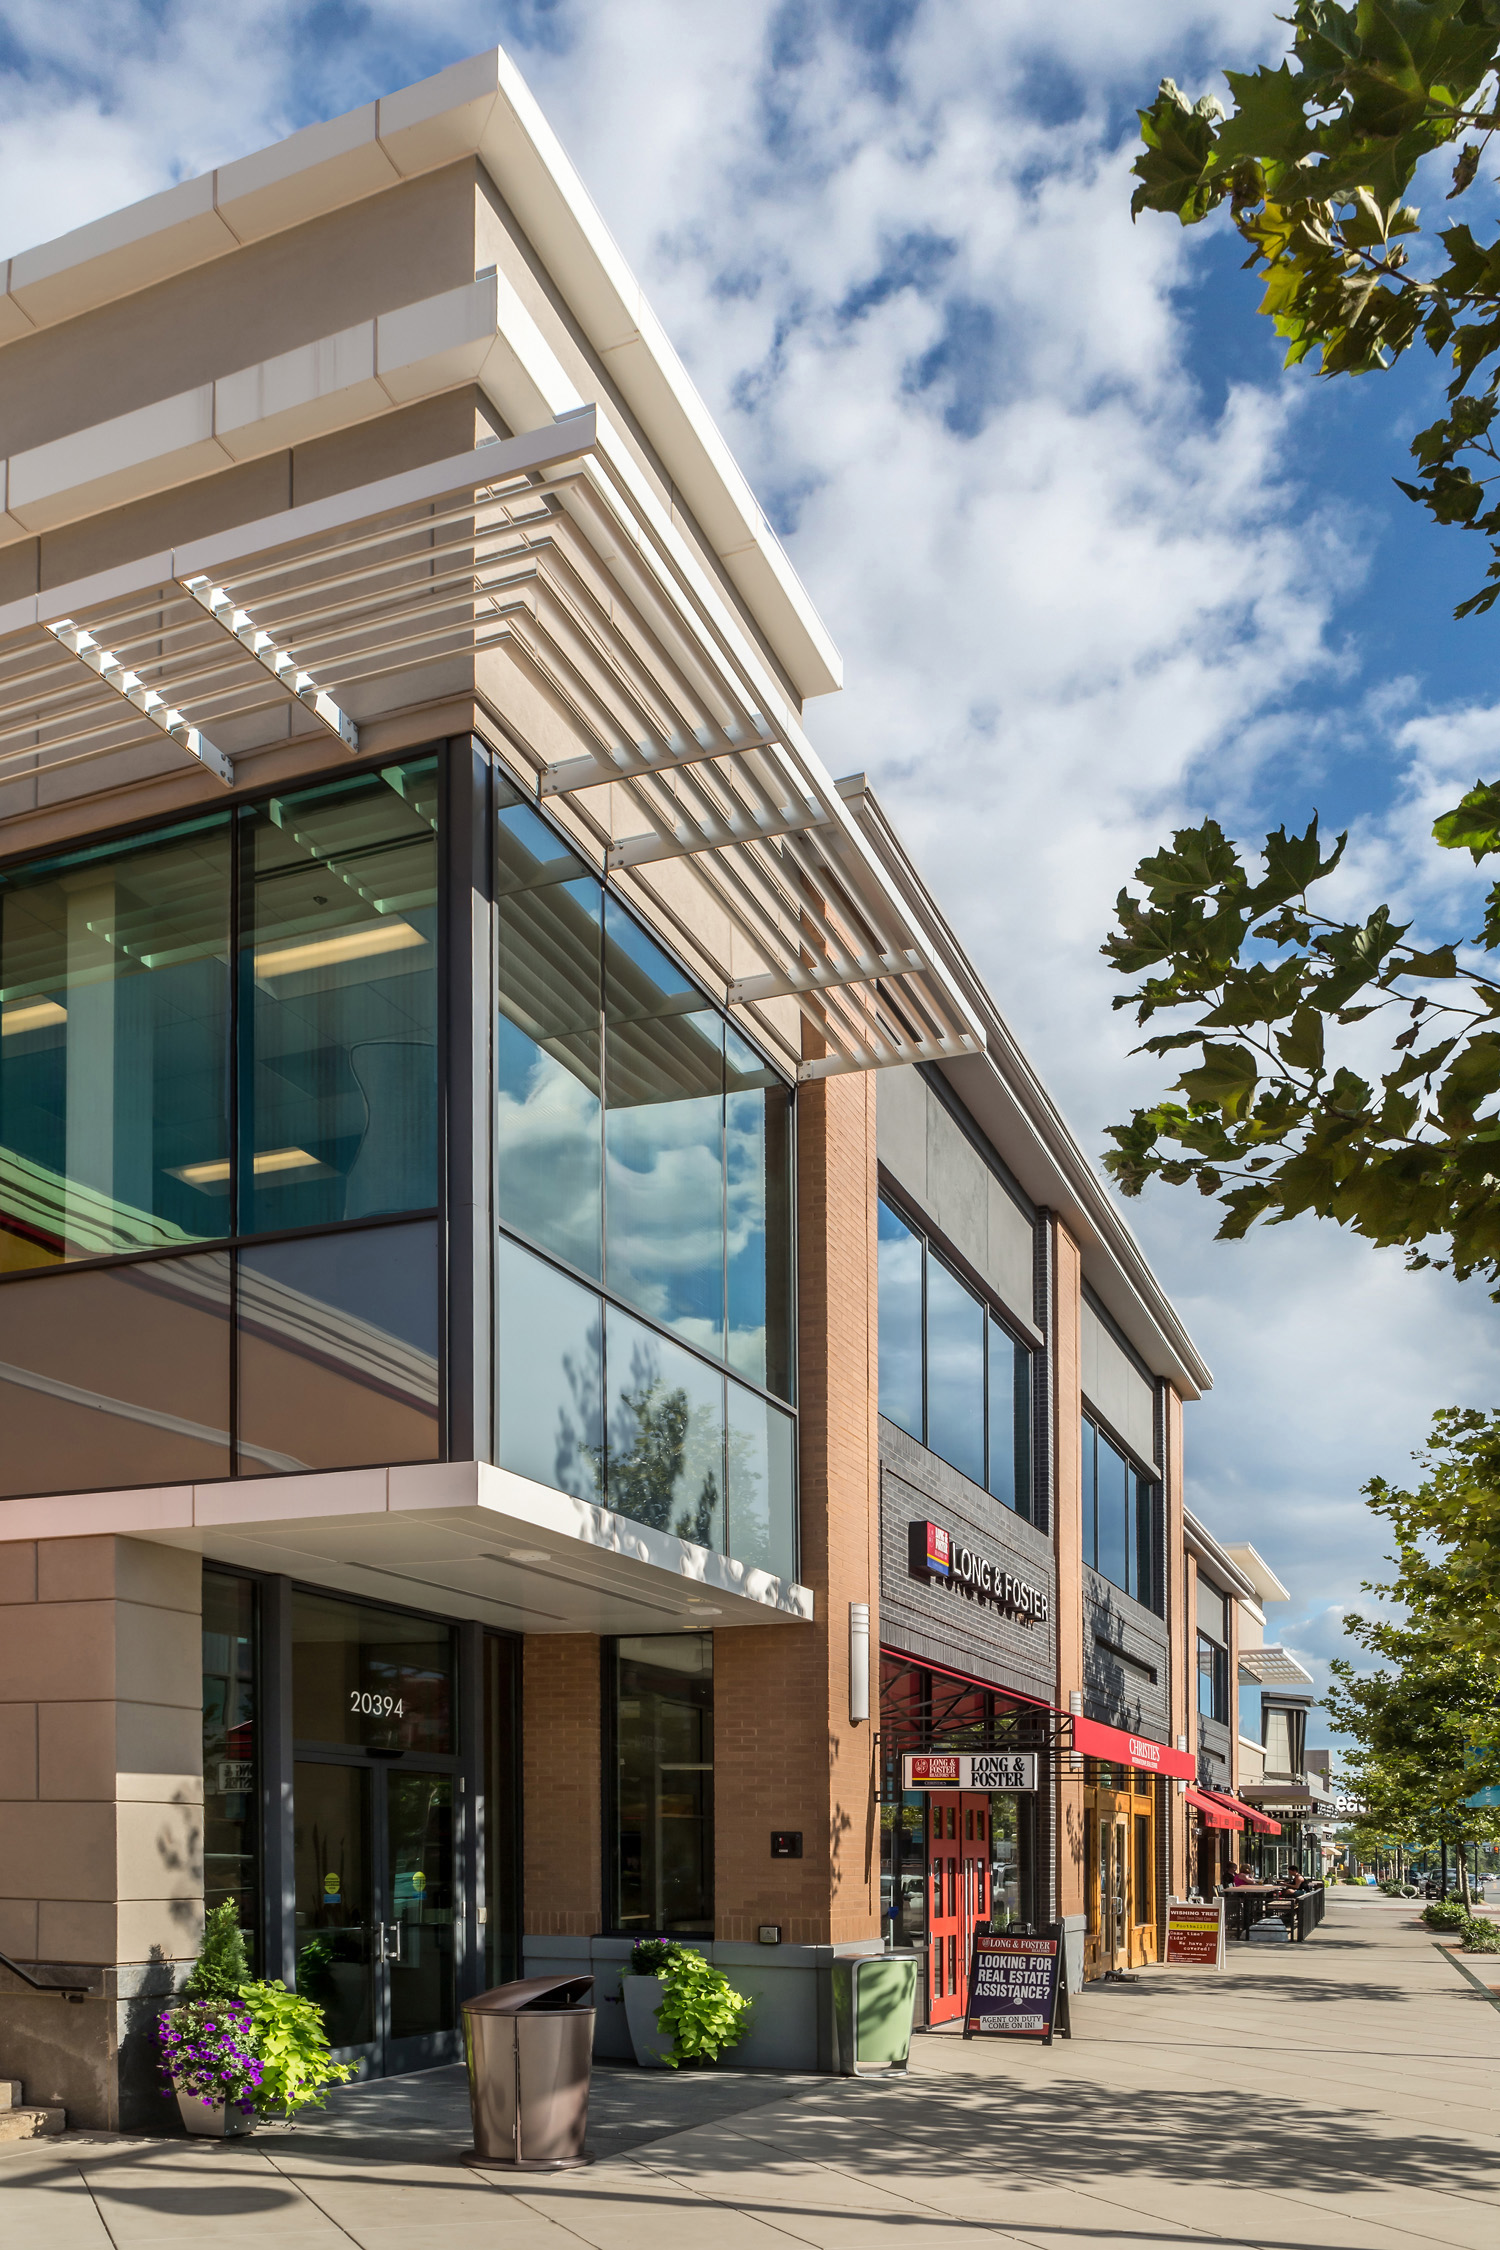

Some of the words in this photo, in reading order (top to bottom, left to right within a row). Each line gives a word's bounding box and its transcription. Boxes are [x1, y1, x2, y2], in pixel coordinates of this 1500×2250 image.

[952, 1542, 991, 1592] LONG
[994, 1566, 1003, 1598] &
[1005, 1573, 1049, 1622] FOSTER
[350, 1690, 404, 1718] 20394
[929, 1758, 948, 1767] LONG
[949, 1758, 956, 1767] &
[929, 1766, 956, 1774] FOSTER
[970, 1757, 1009, 1772] LONG
[1012, 1756, 1025, 1772] &
[970, 1772, 1025, 1787] FOSTER
[990, 1939, 1011, 1948] LONG
[1012, 1940, 1019, 1949] &
[1020, 1940, 1050, 1950] FOSTER
[978, 1954, 1026, 1970] LOOKING
[1029, 1957, 1052, 1971] FOR
[977, 1969, 1006, 1983] REAL
[1009, 1970, 1050, 1985] ESTATE
[974, 1983, 1051, 2000] ASSISTANCE?
[981, 2016, 1007, 2024] AGENT
[1021, 2015, 1042, 2023] DUTY
